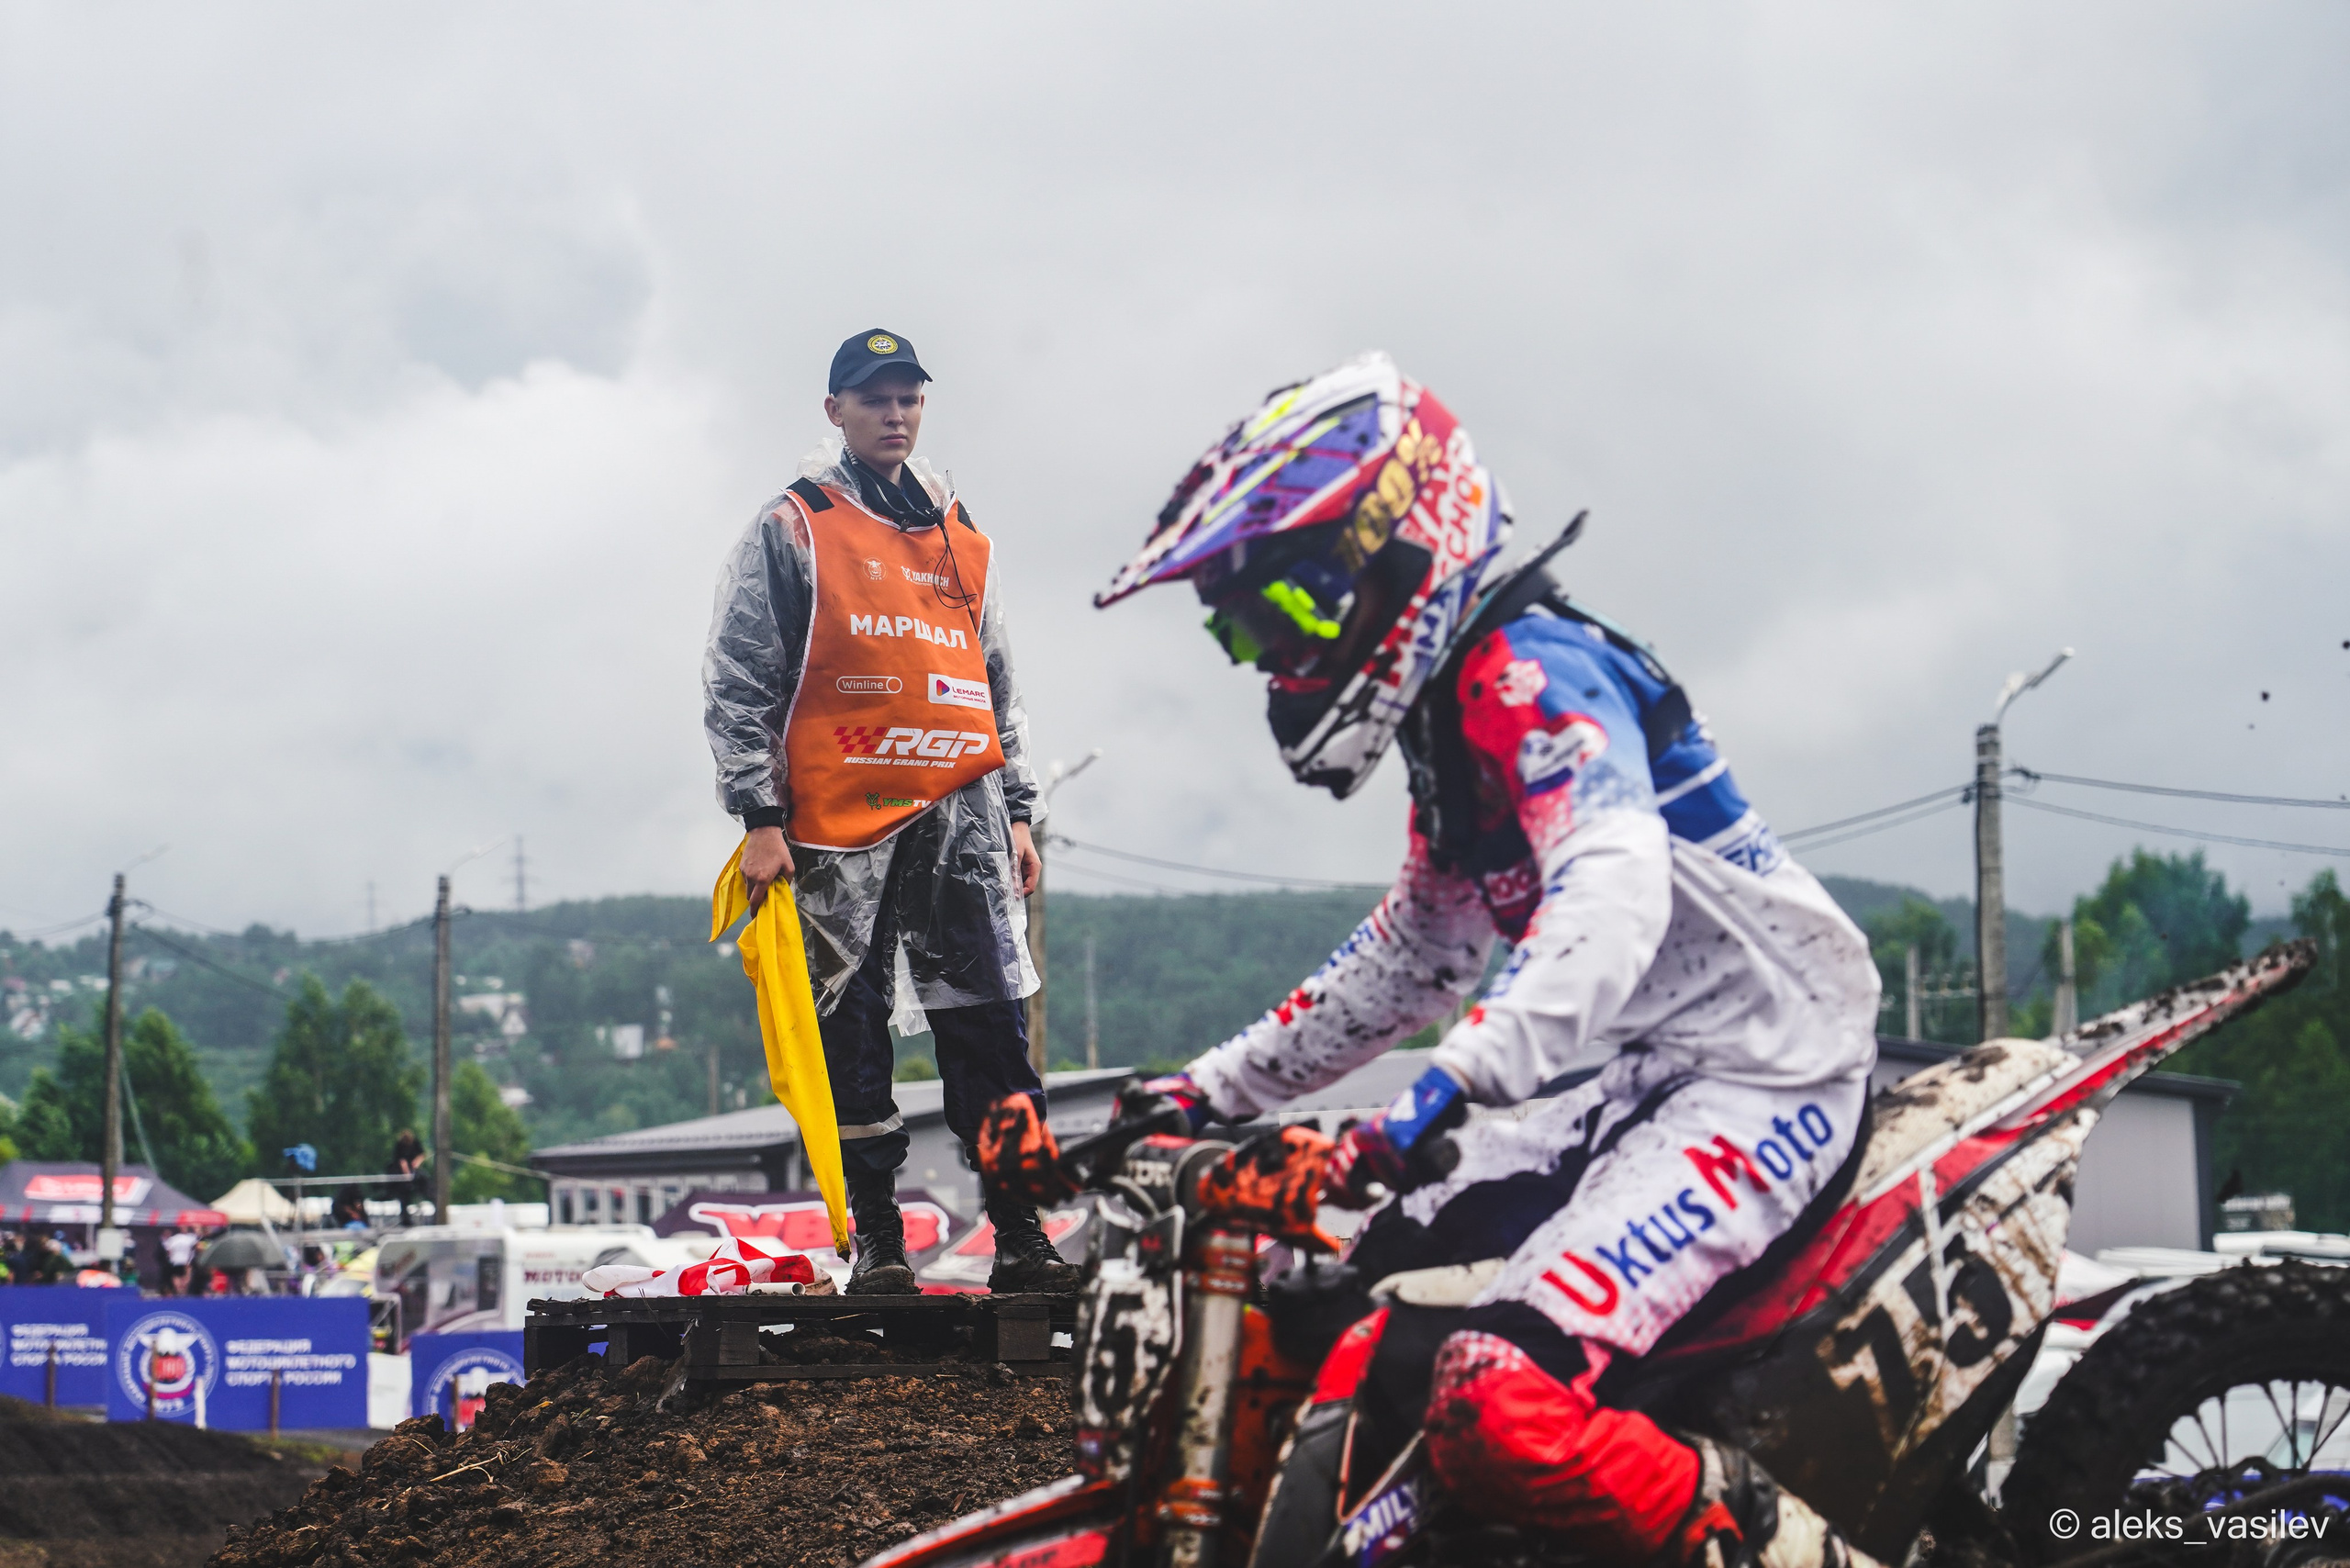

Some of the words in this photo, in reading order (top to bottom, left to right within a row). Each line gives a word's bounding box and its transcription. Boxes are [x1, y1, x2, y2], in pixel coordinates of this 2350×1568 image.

[850, 614, 968, 650] МАРШАЛ
[842, 680, 884, 689] Winline
[952, 686, 986, 699] LEMARC
[875, 726, 990, 759] RGP
[844, 756, 892, 766] RUSSIAN
[892, 758, 929, 767] GRAND
[930, 760, 956, 769] PRIX
